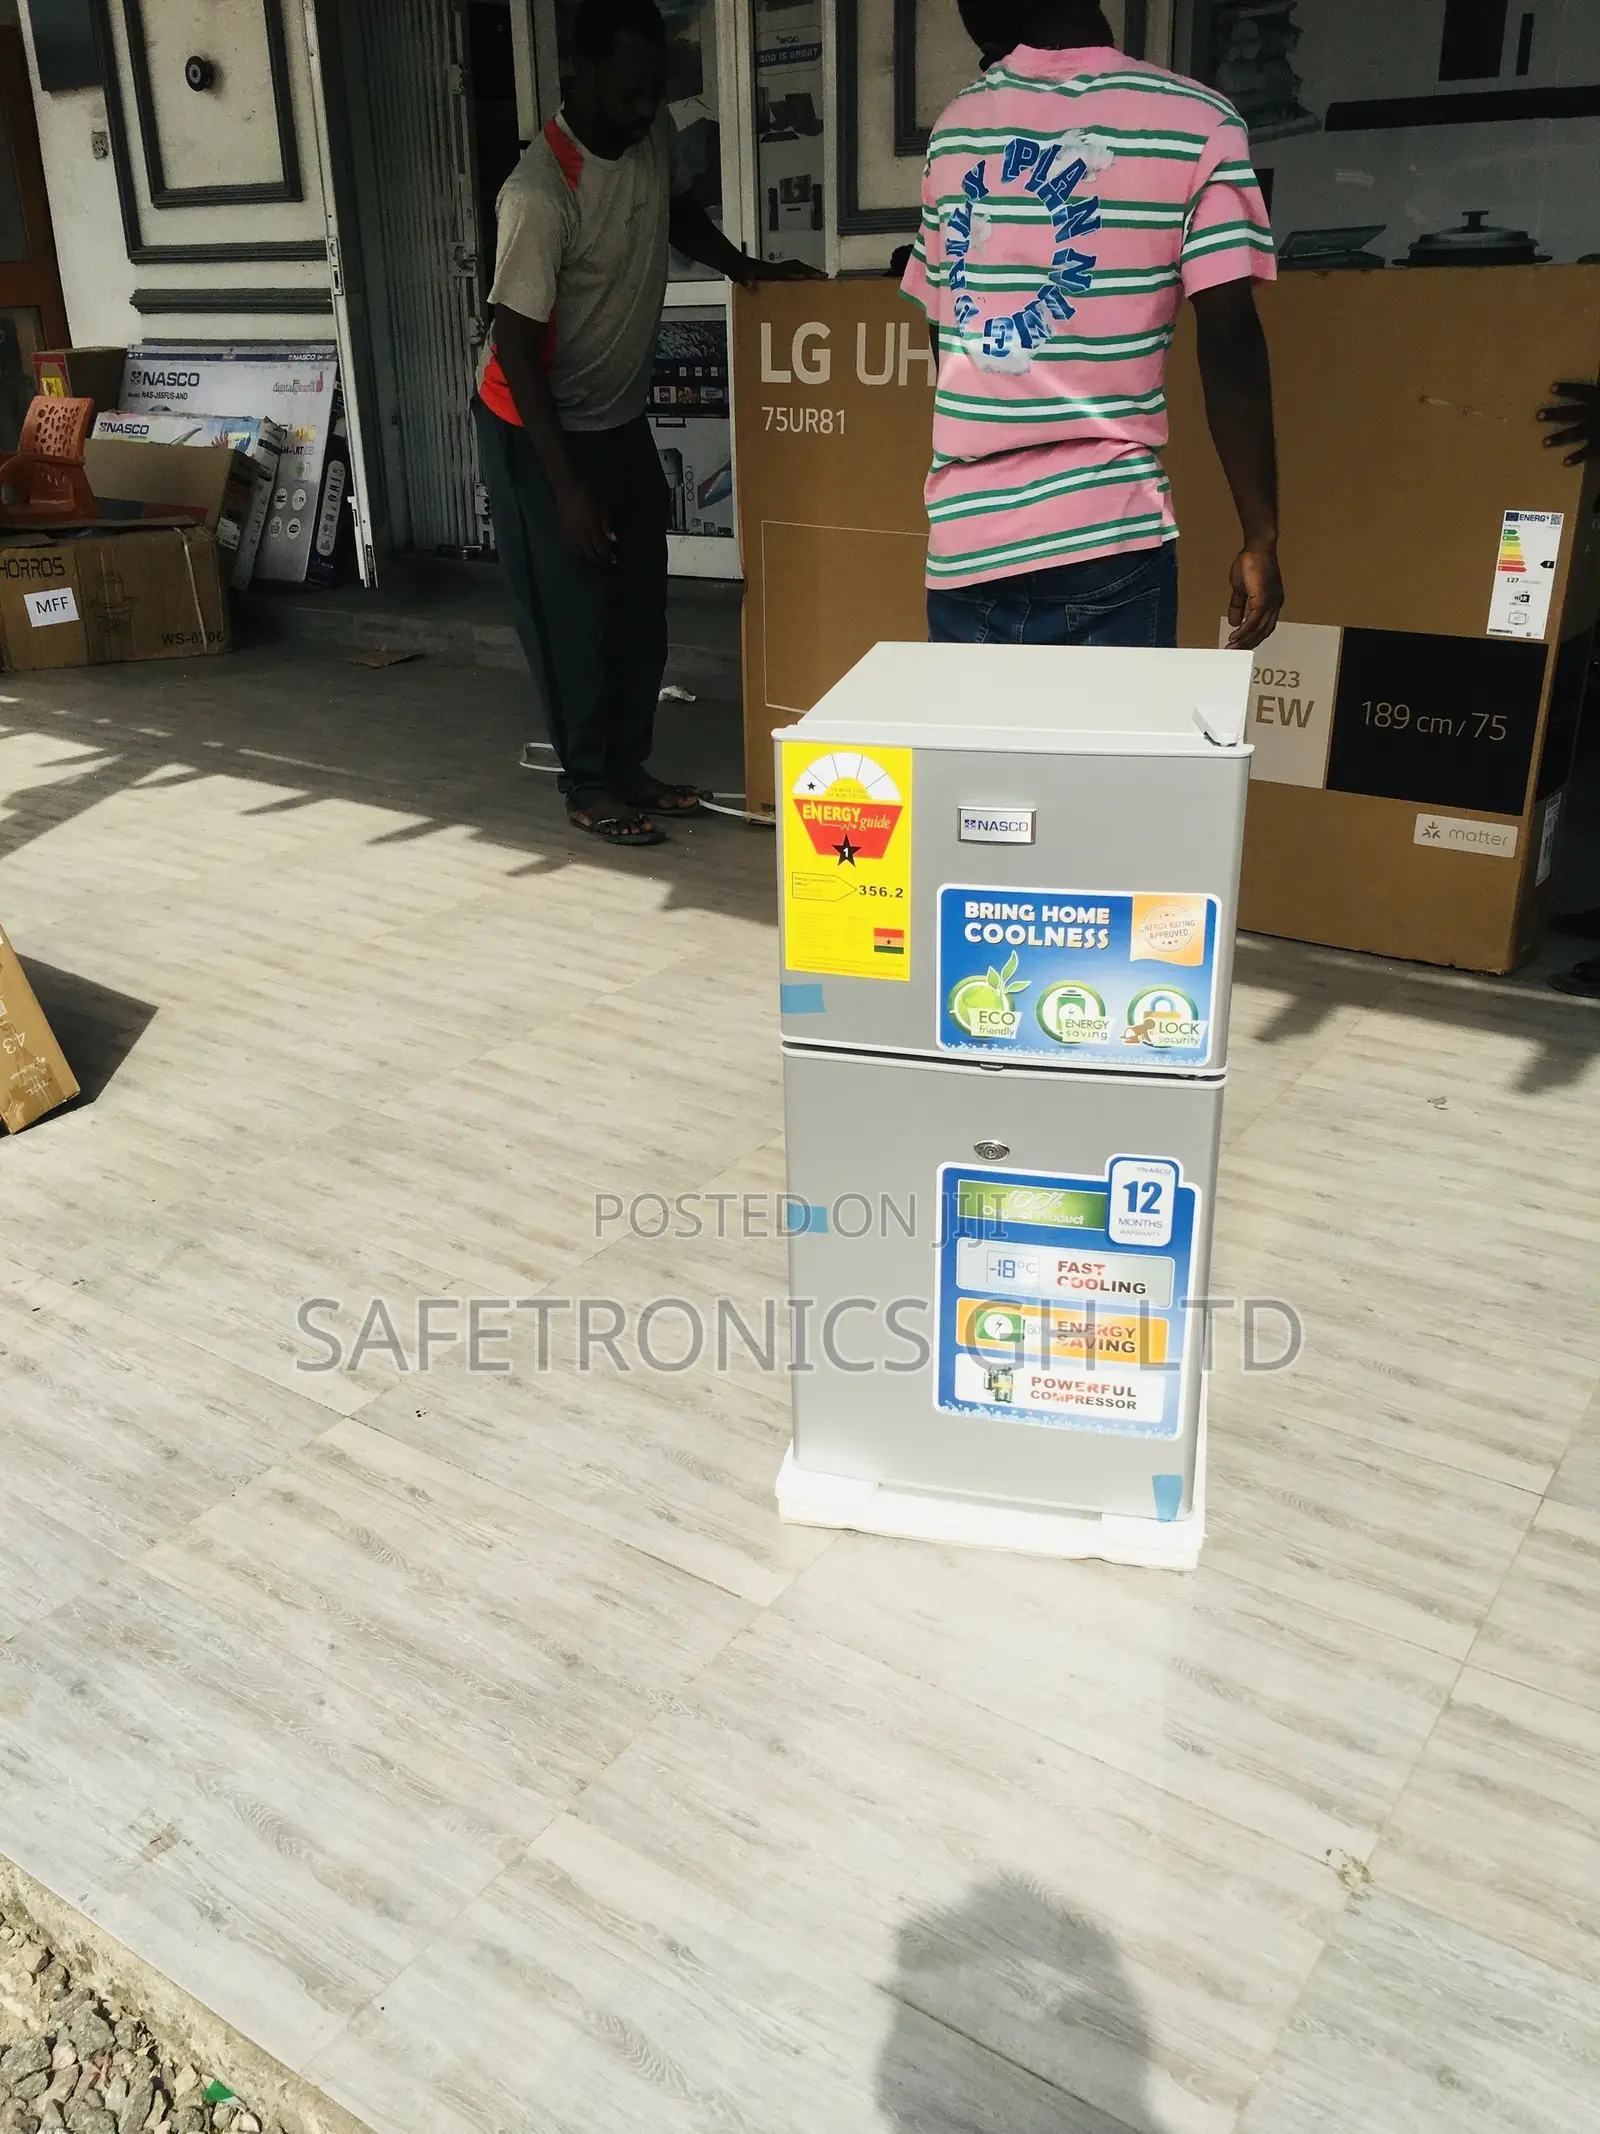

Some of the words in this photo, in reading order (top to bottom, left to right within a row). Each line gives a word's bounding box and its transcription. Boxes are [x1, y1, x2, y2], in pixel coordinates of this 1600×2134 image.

[760, 321, 832, 386] LG
[142, 371, 200, 387] NASCO
[107, 421, 150, 436] NASCO
[762, 406, 846, 434] 75UR81
[1520, 514, 1546, 522] ENERG
[36, 597, 68, 614] MFF
[1252, 666, 1301, 688] 2023
[1256, 695, 1315, 728] EW
[1361, 700, 1410, 729] 189
[1471, 712, 1509, 742] 75
[802, 800, 862, 825] ENERGY
[860, 815, 891, 832] guide
[977, 820, 1030, 833] NASCO
[1448, 828, 1509, 848] matter
[843, 848, 849, 858] 1
[858, 884, 904, 898] 356.2
[964, 902, 1036, 923] BRING
[1042, 905, 1110, 925] HOME
[964, 922, 1110, 950] COOLNESS
[1149, 928, 1189, 940] APPROVED
[978, 1010, 1016, 1026] ECO
[1064, 1018, 1109, 1031] ENERGY
[977, 1024, 1016, 1038] friendly
[1065, 1030, 1108, 1042] saving
[1158, 1020, 1200, 1035] LOCK
[2, 1031, 26, 1055] 43
[1158, 1034, 1200, 1046] security
[1142, 1167, 1172, 1175] NASCO
[1006, 1190, 1066, 1210] 100%
[1122, 1180, 1163, 1214] 12
[982, 1204, 1032, 1221] Original
[1037, 1210, 1085, 1226] Product
[1118, 1217, 1163, 1229] MONTHS
[1120, 1229, 1161, 1238] WARRANTY
[1057, 1260, 1106, 1276] FAST
[1057, 1276, 1146, 1295] COOLING
[1057, 1320, 1137, 1339] ENERGY
[1056, 1336, 1136, 1354] SAVING
[1031, 1376, 1137, 1398] POWERFUL
[1030, 1390, 1137, 1411] COMPRESSOR
